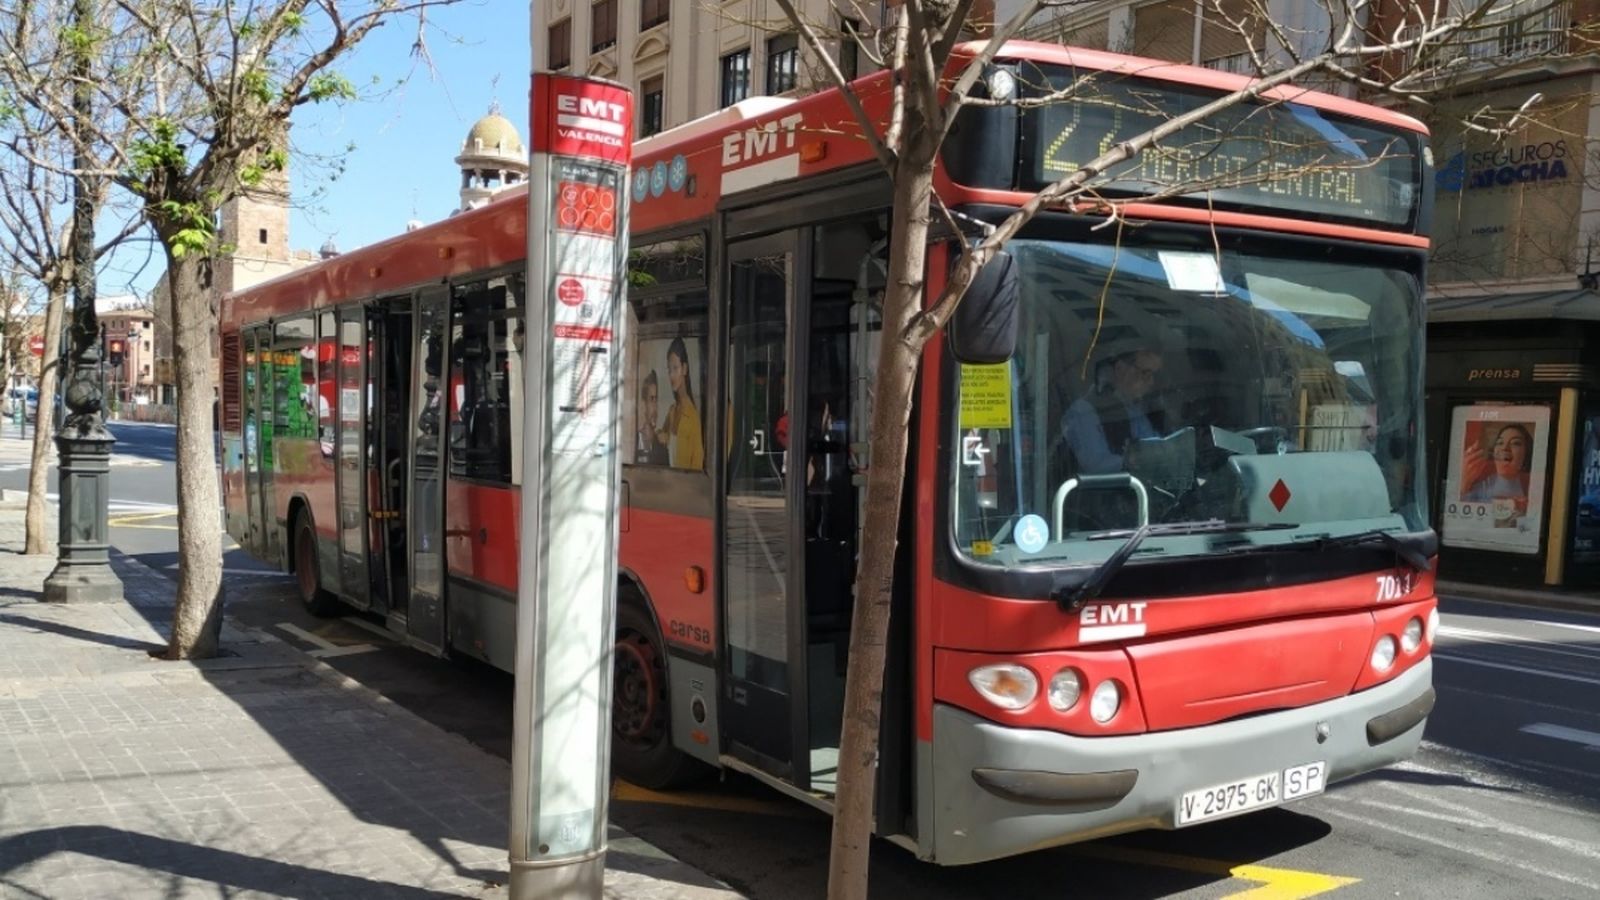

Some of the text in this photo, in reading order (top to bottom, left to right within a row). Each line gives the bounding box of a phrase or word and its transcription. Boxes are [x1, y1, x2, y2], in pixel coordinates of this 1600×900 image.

[557, 94, 625, 121] EMT
[558, 128, 625, 147] VALENCIA
[722, 111, 803, 167] EMT
[1472, 140, 1566, 169] SEGUROS
[1256, 160, 1362, 204] CENTRAL
[1470, 160, 1567, 188] ATOCHA
[1468, 368, 1520, 382] prensa
[1079, 602, 1148, 625] EMT
[670, 619, 711, 644] carsa
[1289, 766, 1320, 794] SP
